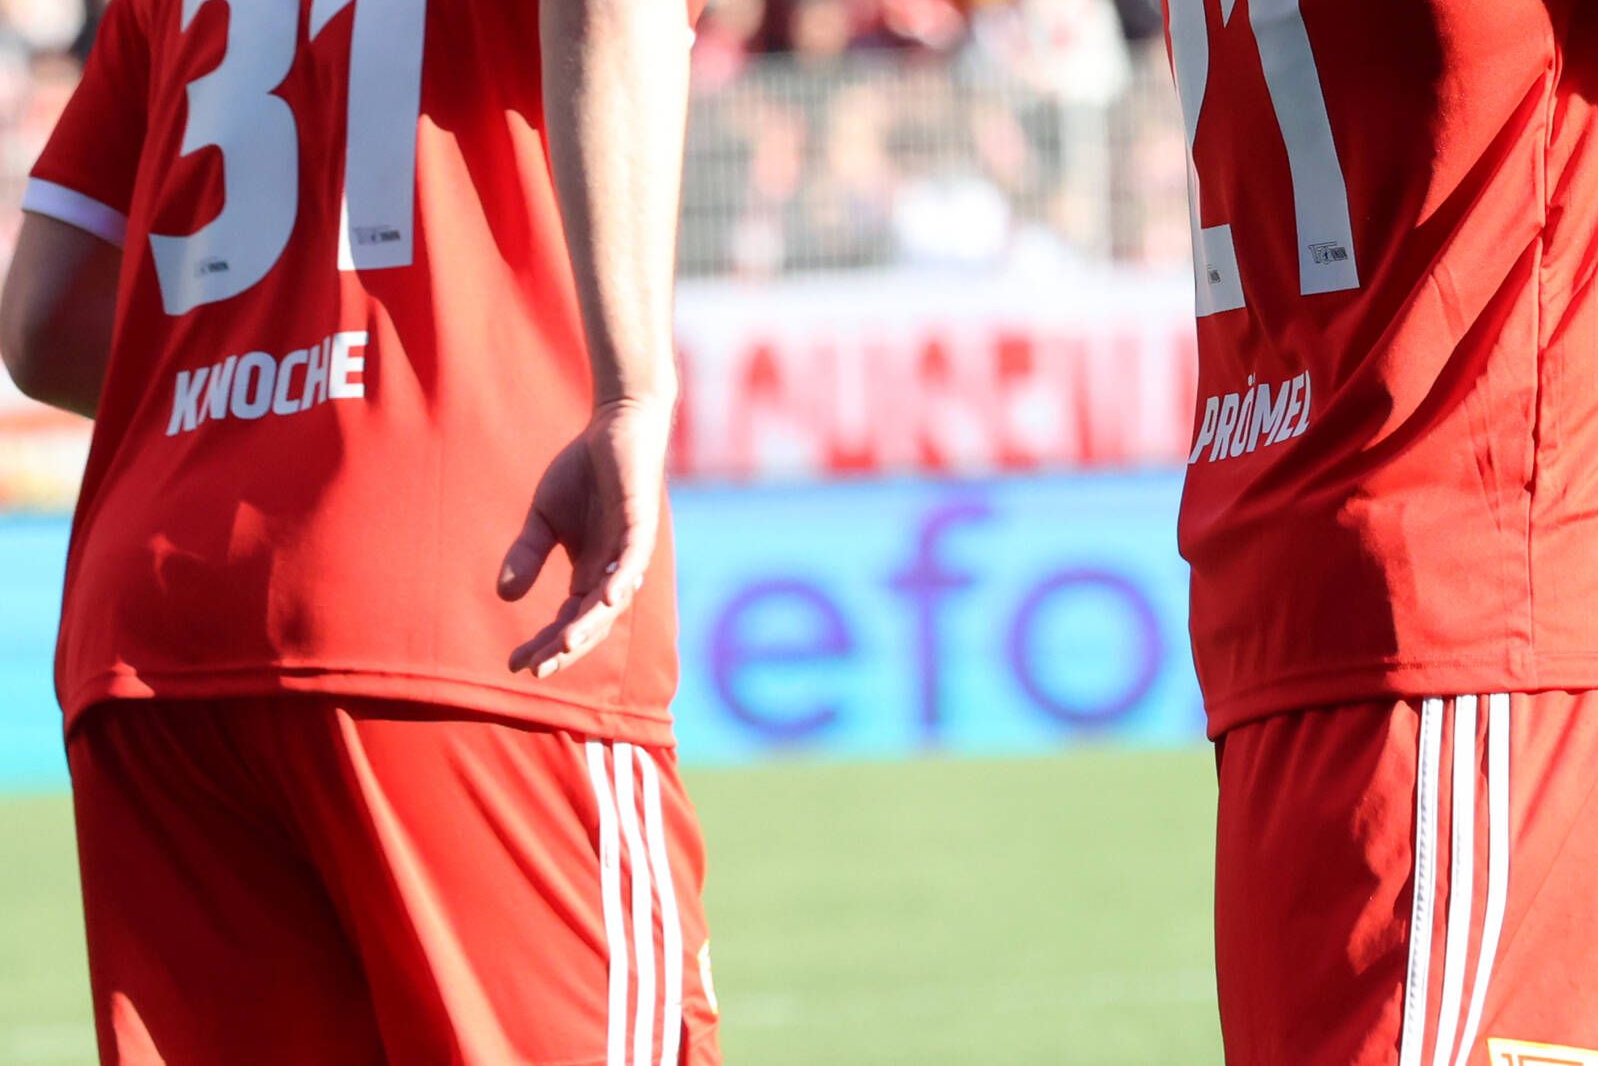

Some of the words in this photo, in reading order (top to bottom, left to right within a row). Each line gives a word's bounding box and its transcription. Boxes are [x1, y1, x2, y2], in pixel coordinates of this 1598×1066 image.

[166, 330, 369, 437] KNOCHE
[1187, 368, 1313, 465] PRÖMEL
[706, 494, 1170, 742] efo
